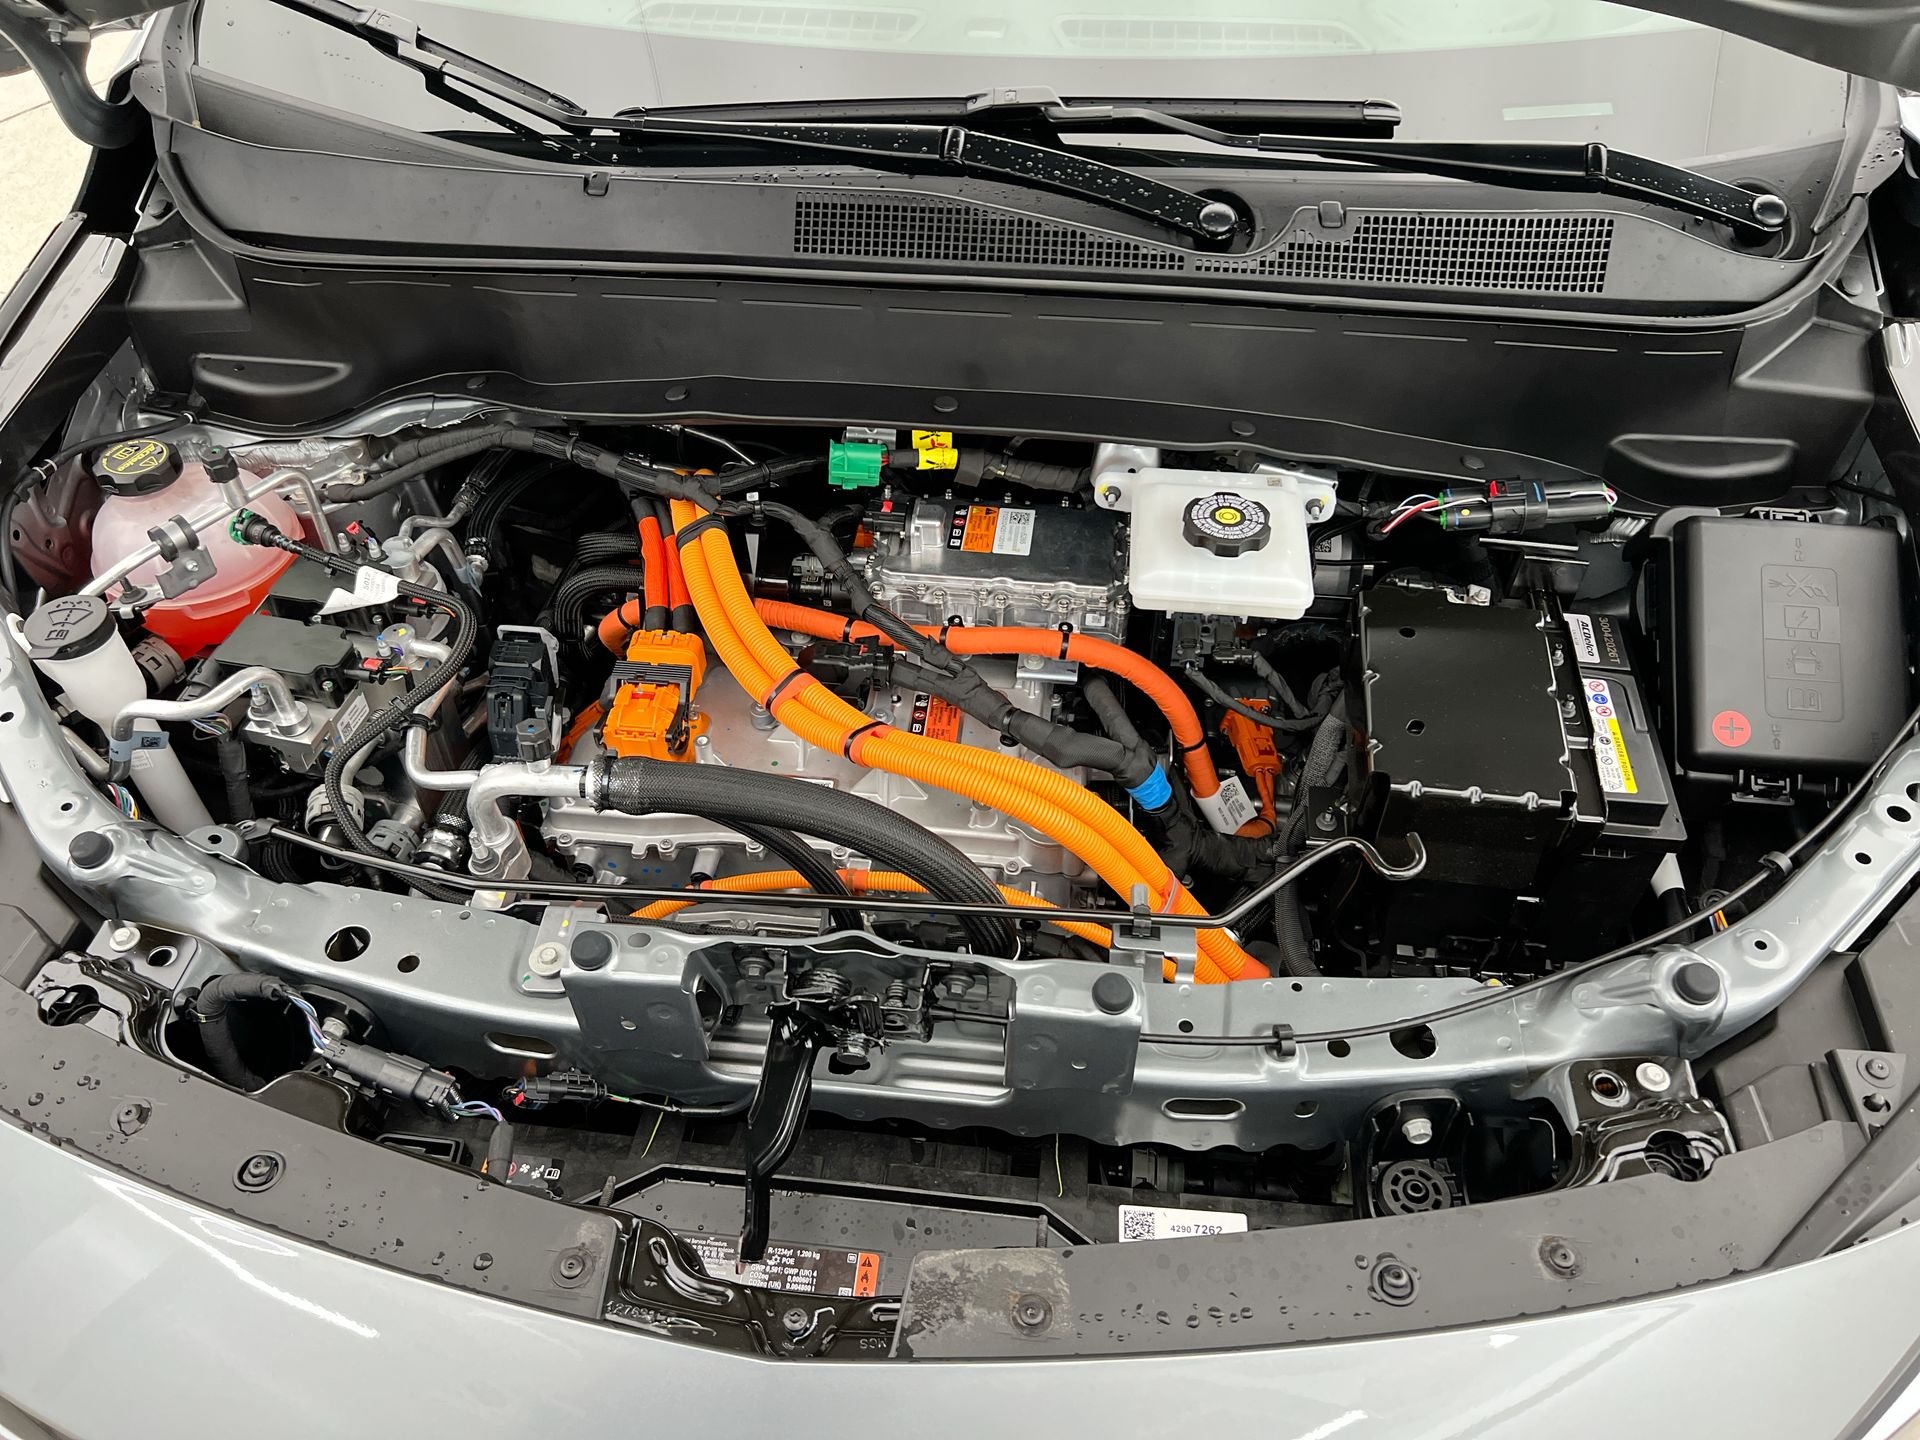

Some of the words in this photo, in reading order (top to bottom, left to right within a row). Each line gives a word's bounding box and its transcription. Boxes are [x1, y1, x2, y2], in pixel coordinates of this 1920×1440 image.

[1580, 620, 1595, 657] ACDelco
[1599, 616, 1621, 665] 30042026T
[1170, 1225, 1191, 1233] 4290
[767, 1247, 794, 1257] R-1234yf
[812, 1251, 821, 1260] kg
[781, 1257, 795, 1265] POE
[750, 1264, 765, 1272] GWP
[784, 1267, 798, 1275] GWP
[799, 1269, 812, 1277] (UK)
